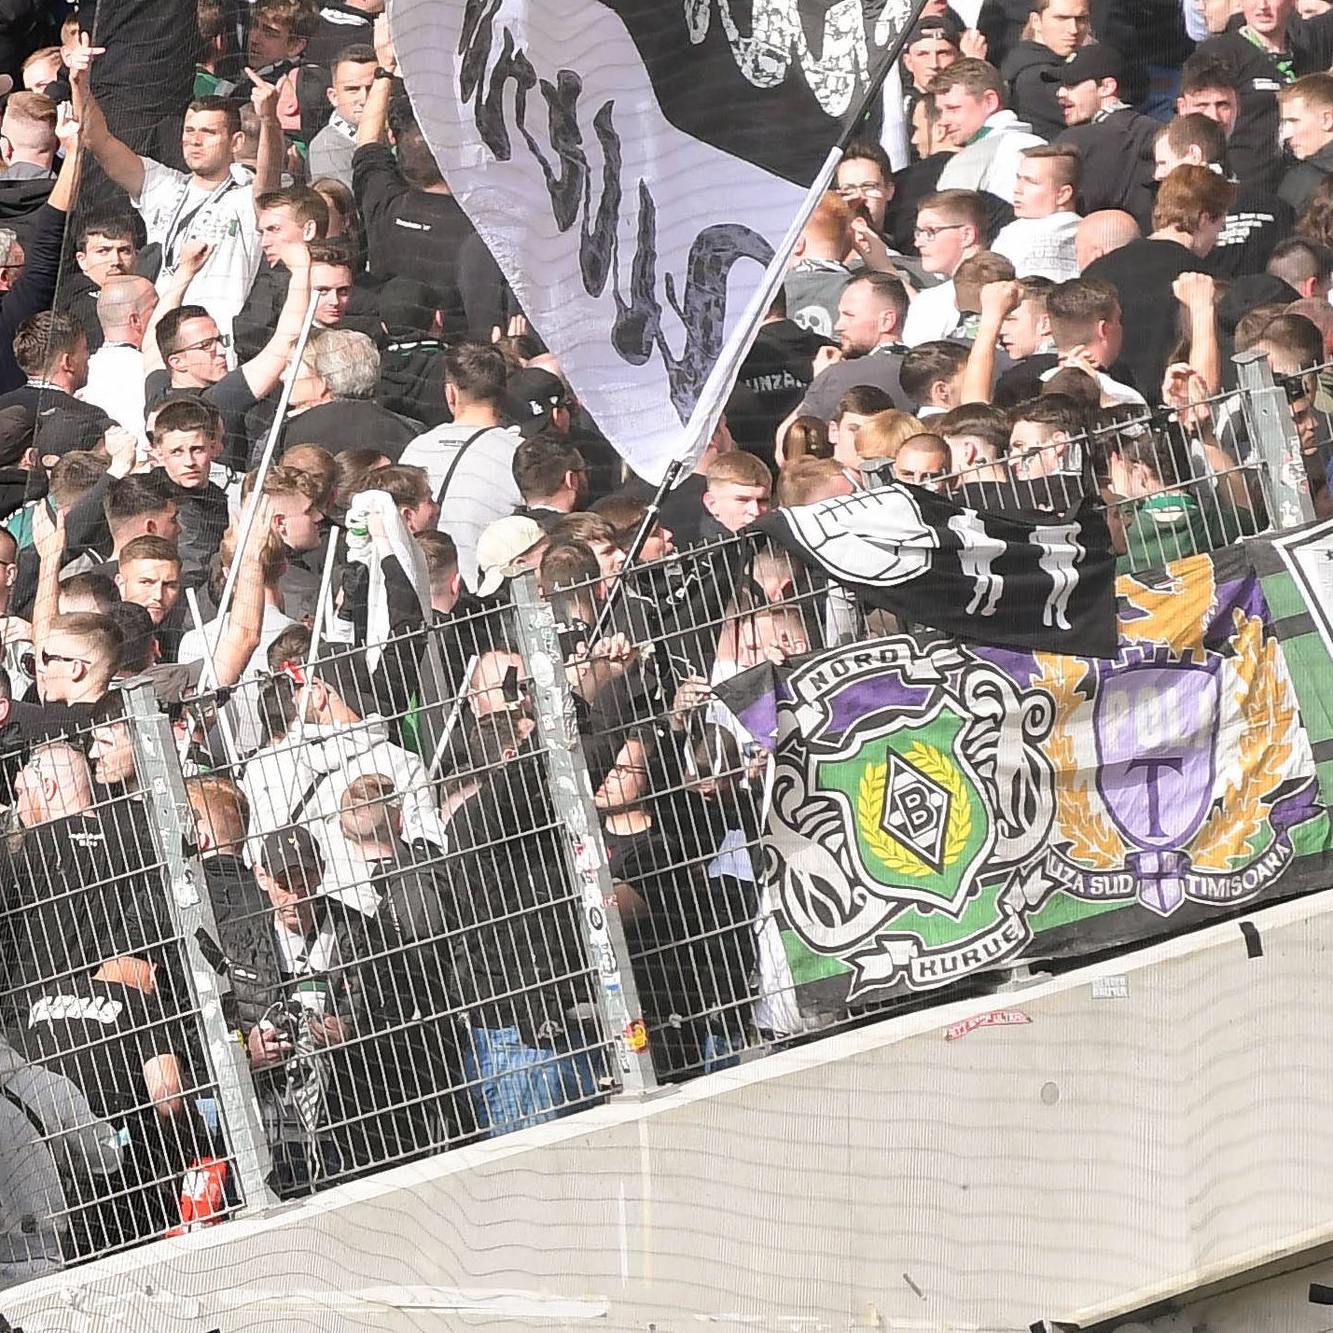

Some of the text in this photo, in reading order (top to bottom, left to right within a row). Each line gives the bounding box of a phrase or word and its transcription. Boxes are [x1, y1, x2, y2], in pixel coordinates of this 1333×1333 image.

[809, 649, 899, 689] NORD
[1123, 758, 1184, 838] T
[1090, 873, 1134, 896] SUD
